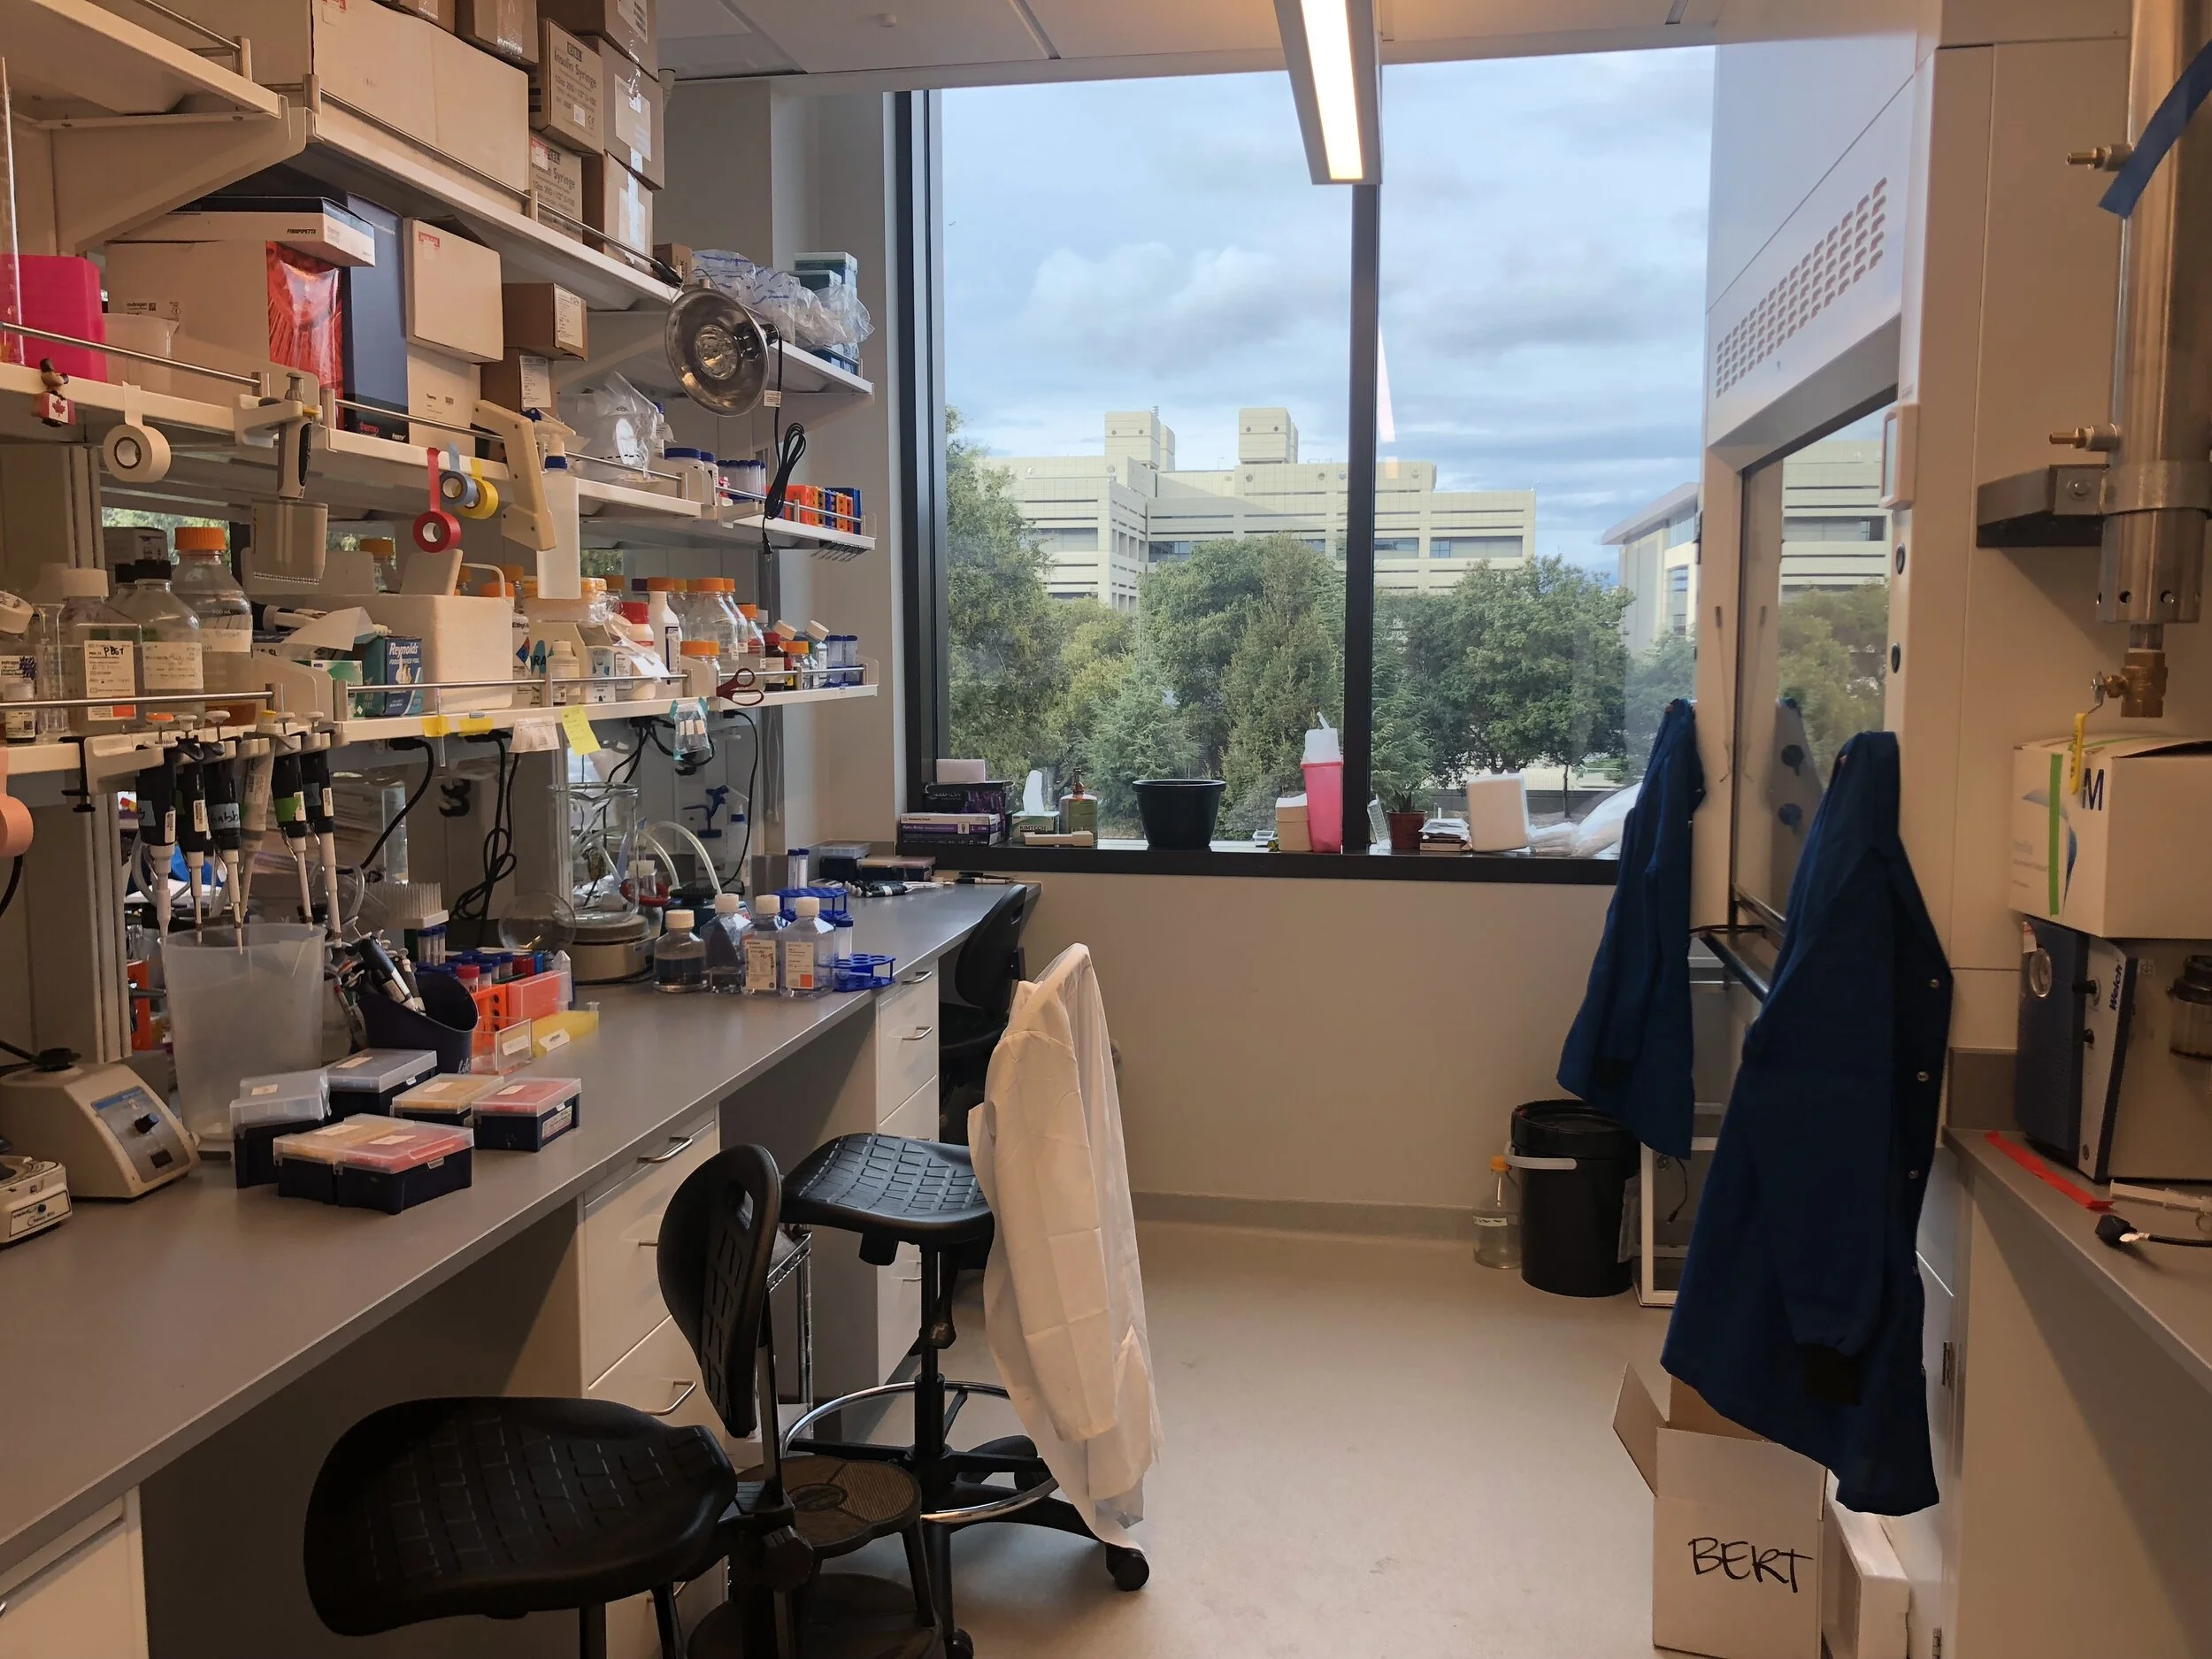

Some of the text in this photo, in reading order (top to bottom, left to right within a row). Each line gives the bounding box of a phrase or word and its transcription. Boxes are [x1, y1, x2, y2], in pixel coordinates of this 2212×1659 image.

[575, 63, 597, 89] Syringe
[553, 167, 575, 190] Syringe
[389, 641, 419, 658] Reynolds
[2082, 767, 2105, 811] M
[2108, 964, 2124, 1011] Welch
[1687, 1536, 1814, 1594] BERT
